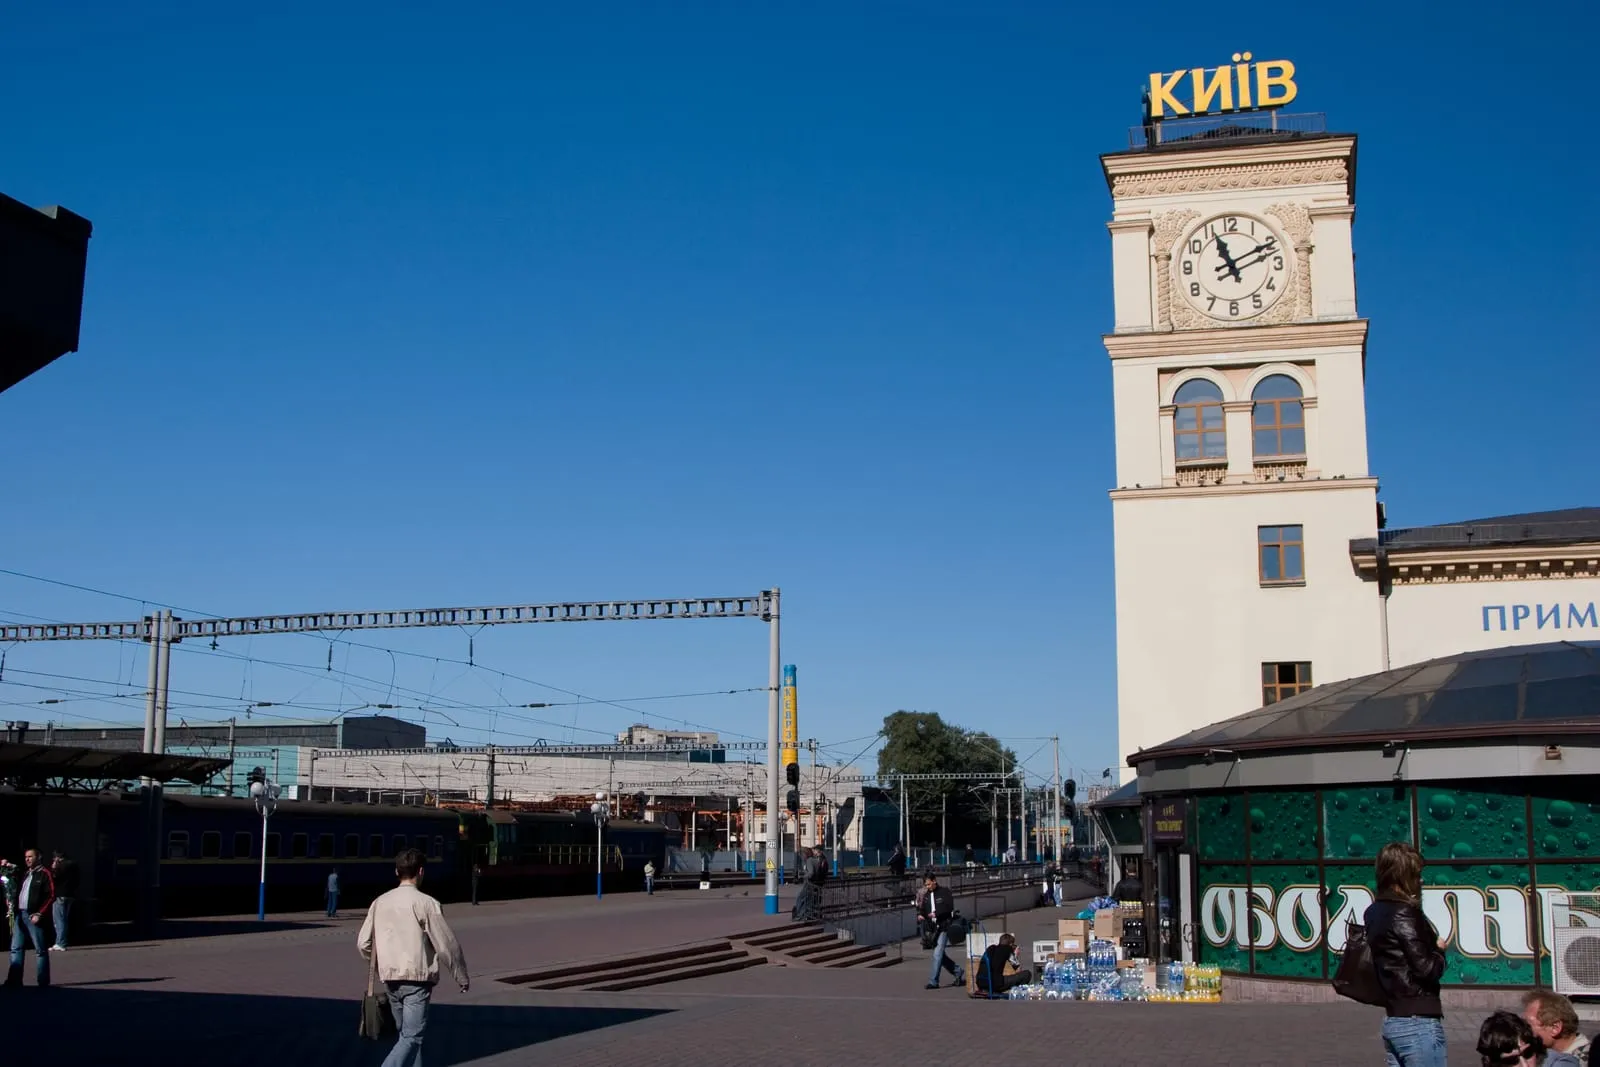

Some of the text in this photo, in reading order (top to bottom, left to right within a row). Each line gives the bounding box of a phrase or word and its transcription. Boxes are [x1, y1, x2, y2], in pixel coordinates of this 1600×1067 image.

[1149, 52, 1298, 117] КИЇВ
[1223, 217, 1238, 232] 12
[1188, 239, 1202, 255] 10
[1183, 260, 1193, 275] 9
[1273, 255, 1284, 271] 3
[1190, 282, 1200, 297] 8
[1266, 276, 1276, 292] 4
[1206, 295, 1217, 312] 7
[1229, 301, 1239, 316] 6
[1252, 294, 1262, 309] 5
[1482, 602, 1598, 631] ПРИМ
